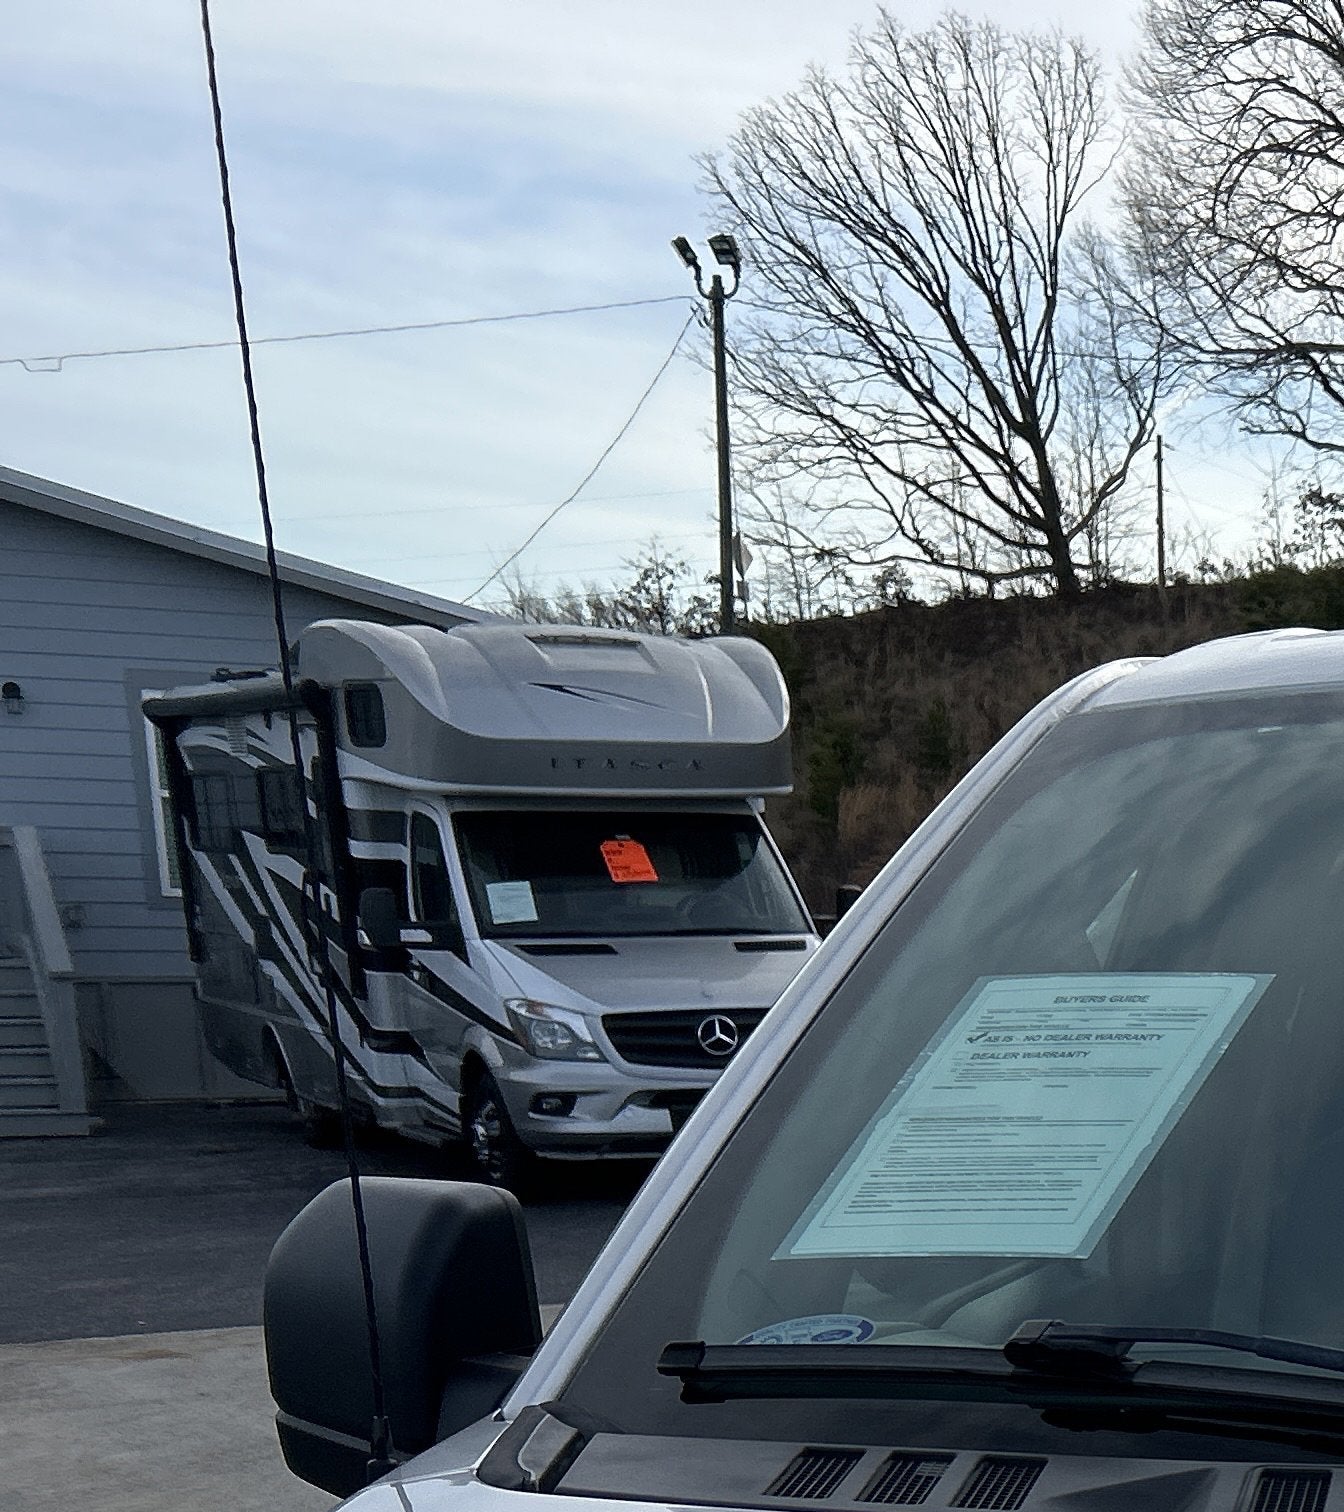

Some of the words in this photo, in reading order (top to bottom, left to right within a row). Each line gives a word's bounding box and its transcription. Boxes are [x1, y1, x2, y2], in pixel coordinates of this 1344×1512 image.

[1109, 995, 1150, 1003] GUIDE
[1024, 1034, 1042, 1042] NO
[1043, 1034, 1092, 1042] DEALER
[1095, 1033, 1164, 1041] WARRANTY
[970, 1052, 1020, 1060] DEALER
[1022, 1050, 1092, 1059] WARRANTY
